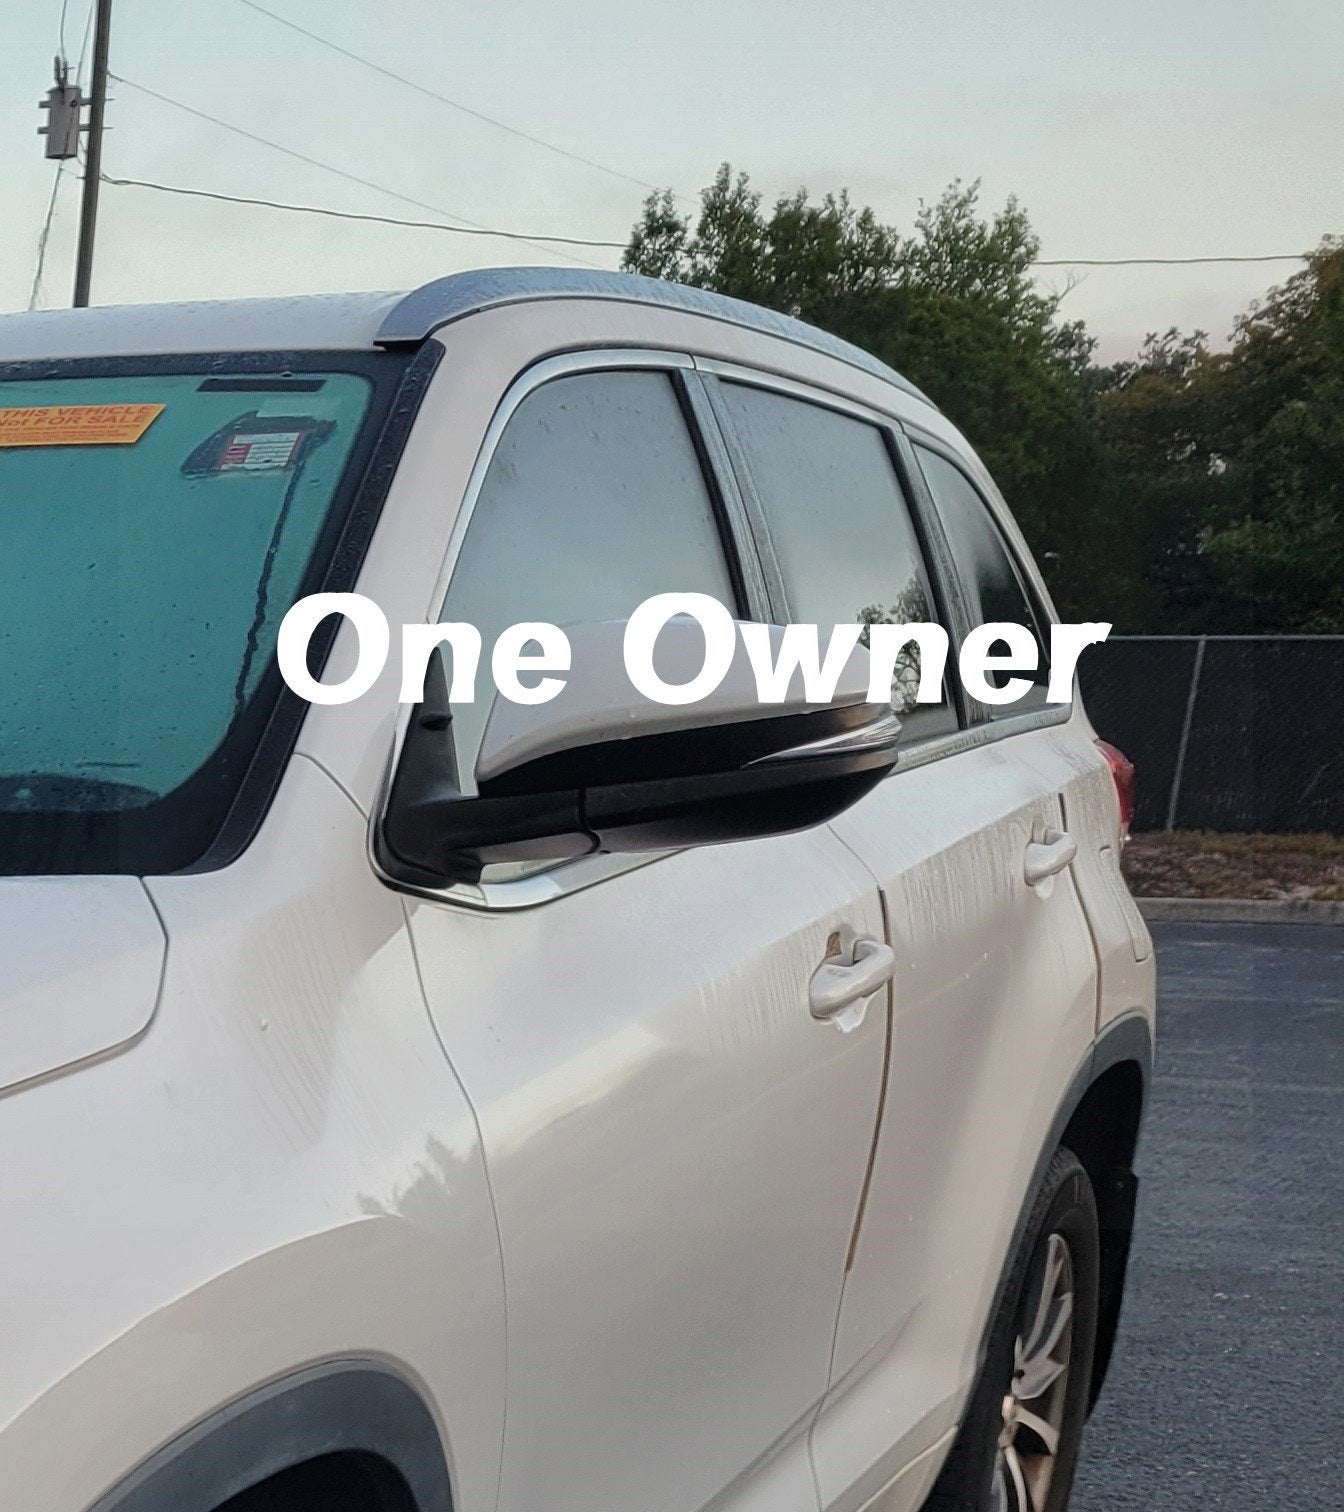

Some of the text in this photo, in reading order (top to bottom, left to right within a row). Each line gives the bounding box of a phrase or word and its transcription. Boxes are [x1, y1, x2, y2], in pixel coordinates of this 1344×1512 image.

[0, 404, 155, 418] THIS VEHICLE
[33, 416, 82, 426] FOR
[86, 414, 147, 424] SALE
